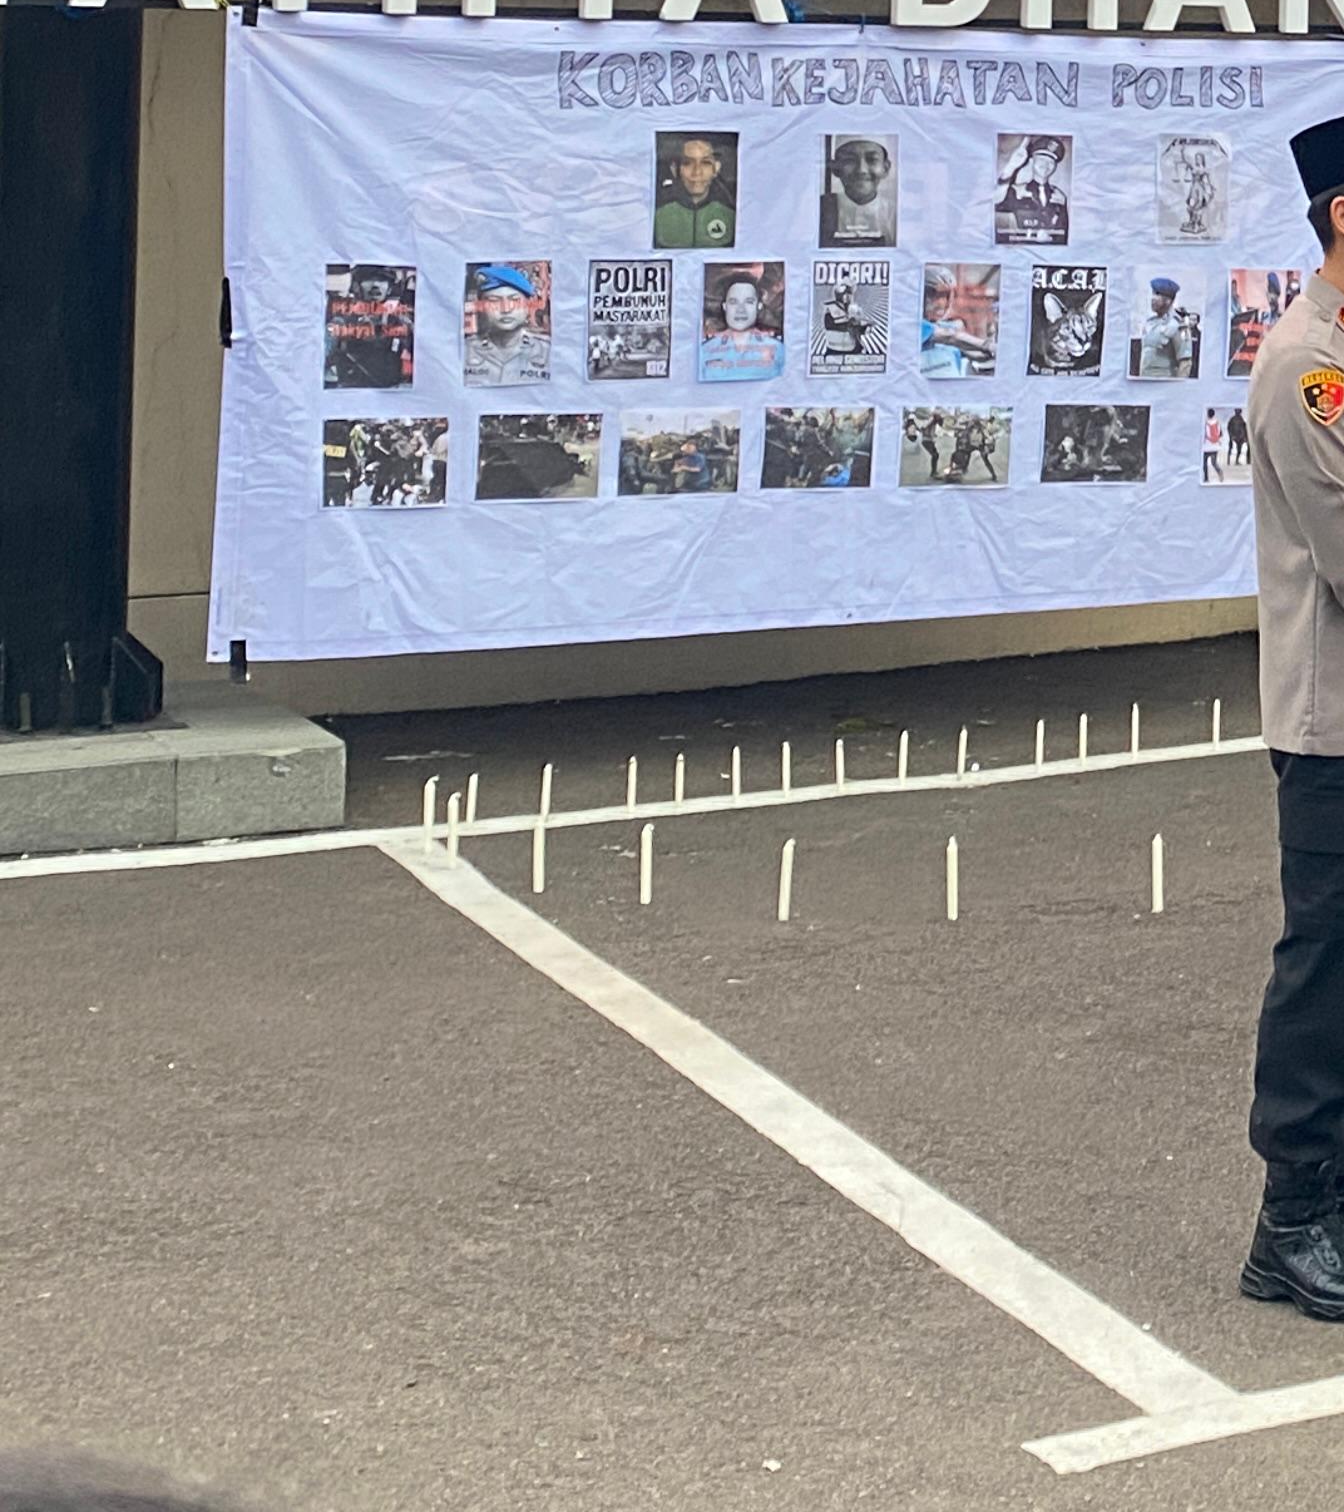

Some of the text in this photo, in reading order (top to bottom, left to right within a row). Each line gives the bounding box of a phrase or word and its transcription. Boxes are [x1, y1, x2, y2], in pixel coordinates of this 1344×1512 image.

[557, 50, 1265, 110] KORBAN KEJAHATAN POLISI
[595, 267, 666, 294] POLRI
[814, 262, 889, 285] DICARI!
[593, 296, 666, 308] PEMBUNUH
[593, 309, 666, 323] MASYARAKAT
